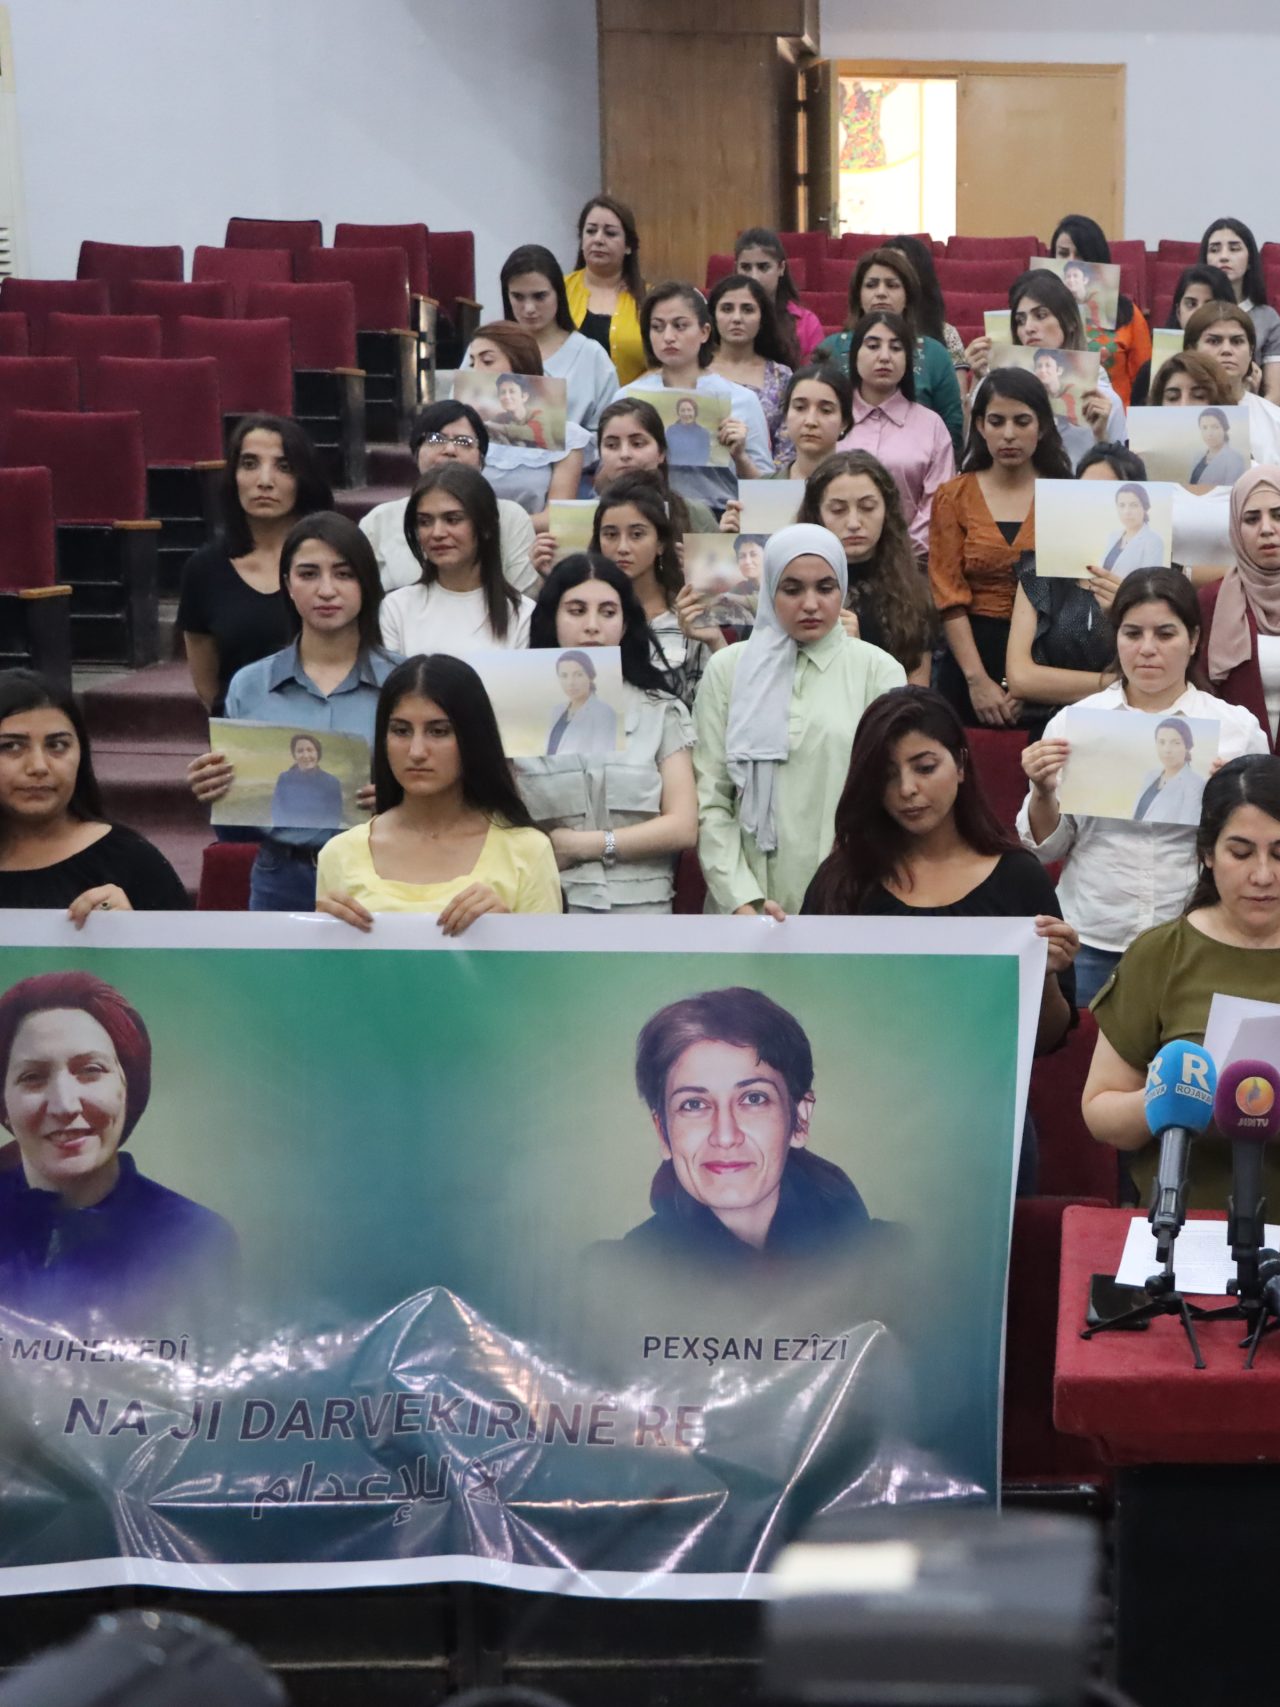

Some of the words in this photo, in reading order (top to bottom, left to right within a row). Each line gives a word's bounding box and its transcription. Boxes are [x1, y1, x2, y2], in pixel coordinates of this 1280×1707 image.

[1182, 1052, 1211, 1092] R
[1177, 1085, 1212, 1105] ROJAVA
[643, 1335, 763, 1366] PEXŞAN
[773, 1333, 850, 1361] EZÎZÎ
[64, 1397, 149, 1436] NA
[169, 1398, 223, 1441] JI
[251, 1455, 451, 1526] للإعدام
